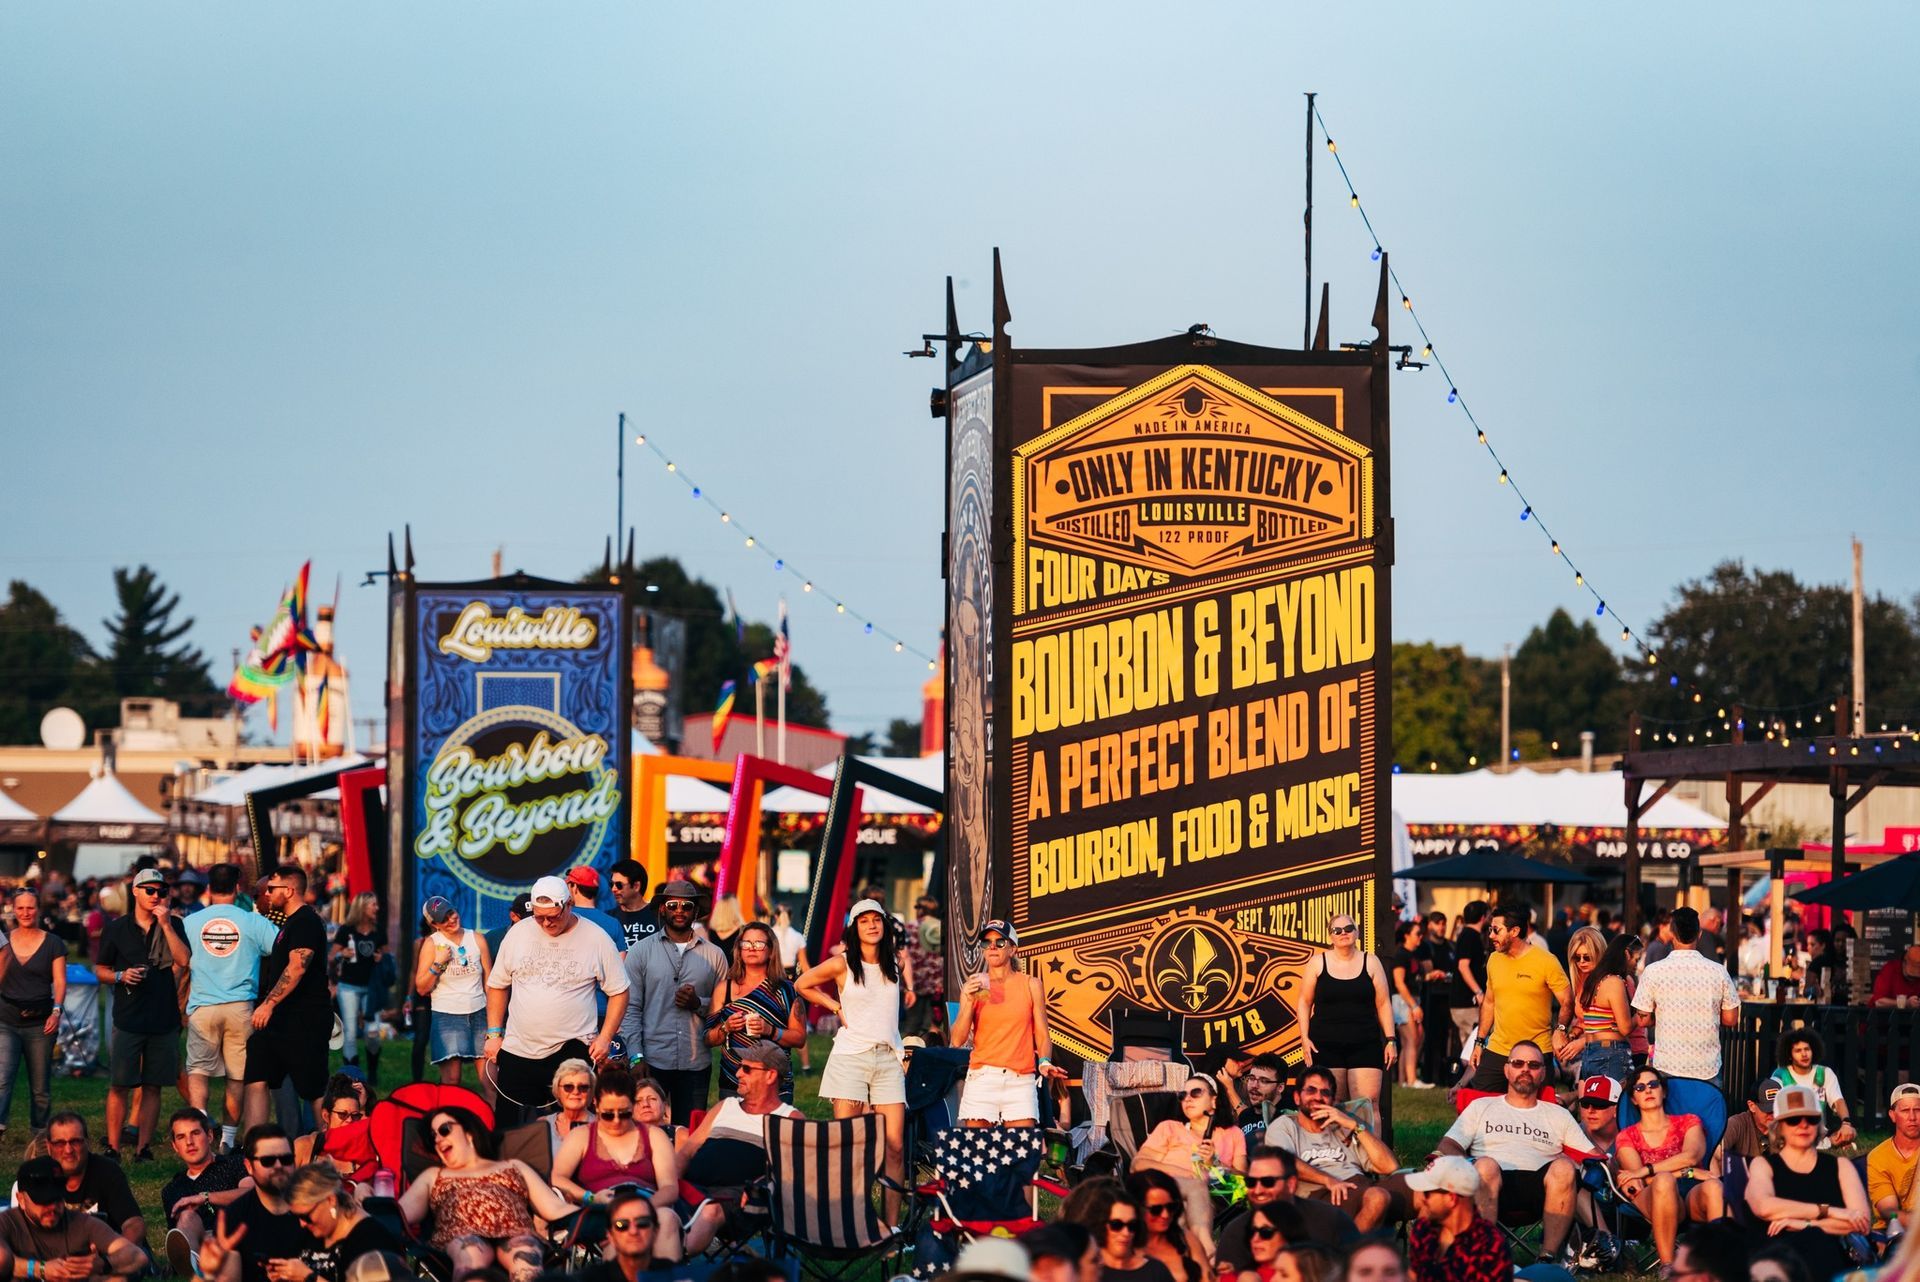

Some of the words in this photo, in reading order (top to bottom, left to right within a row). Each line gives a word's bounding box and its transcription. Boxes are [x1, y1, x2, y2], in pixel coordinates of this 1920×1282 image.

[1134, 422, 1170, 436] MADE
[1175, 421, 1189, 433] IN
[1195, 421, 1252, 435] AMERICA
[1068, 450, 1134, 503] ONLY
[1144, 448, 1176, 492] IN
[1181, 448, 1323, 503] KENTUCKY
[1056, 510, 1131, 543] DISTILLED
[1141, 503, 1246, 522] LOUISVILLE
[1257, 510, 1328, 543] BOTTLED
[1159, 531, 1181, 544] 122
[1188, 531, 1230, 544] PROOF
[1029, 547, 1097, 611] FOUR
[1104, 561, 1170, 597] DAYS
[441, 602, 596, 661] Louisville
[1012, 606, 1184, 739] BOURBON
[1194, 599, 1221, 698] &
[1231, 565, 1375, 690] BEYOND
[1028, 750, 1051, 821] A
[1060, 716, 1199, 813] PERFECT
[1208, 690, 1309, 779] BLEND
[1319, 678, 1359, 755] OF
[427, 731, 608, 809] Bourbon
[415, 805, 457, 857] &
[459, 770, 621, 857] Beyond
[680, 827, 726, 843] STOR
[1030, 817, 1166, 899] BOURBON,
[1172, 799, 1242, 866] FOOD
[1249, 793, 1269, 849] &
[1276, 772, 1361, 843] MUSIC
[1596, 841, 1648, 858] PAPY
[1650, 842, 1663, 858] &
[1666, 842, 1691, 858] CO
[623, 922, 656, 933] VÉLO
[1236, 907, 1267, 934] SEPT.
[1202, 1007, 1267, 1049] 1778
[1485, 1120, 1550, 1139] bourbon
